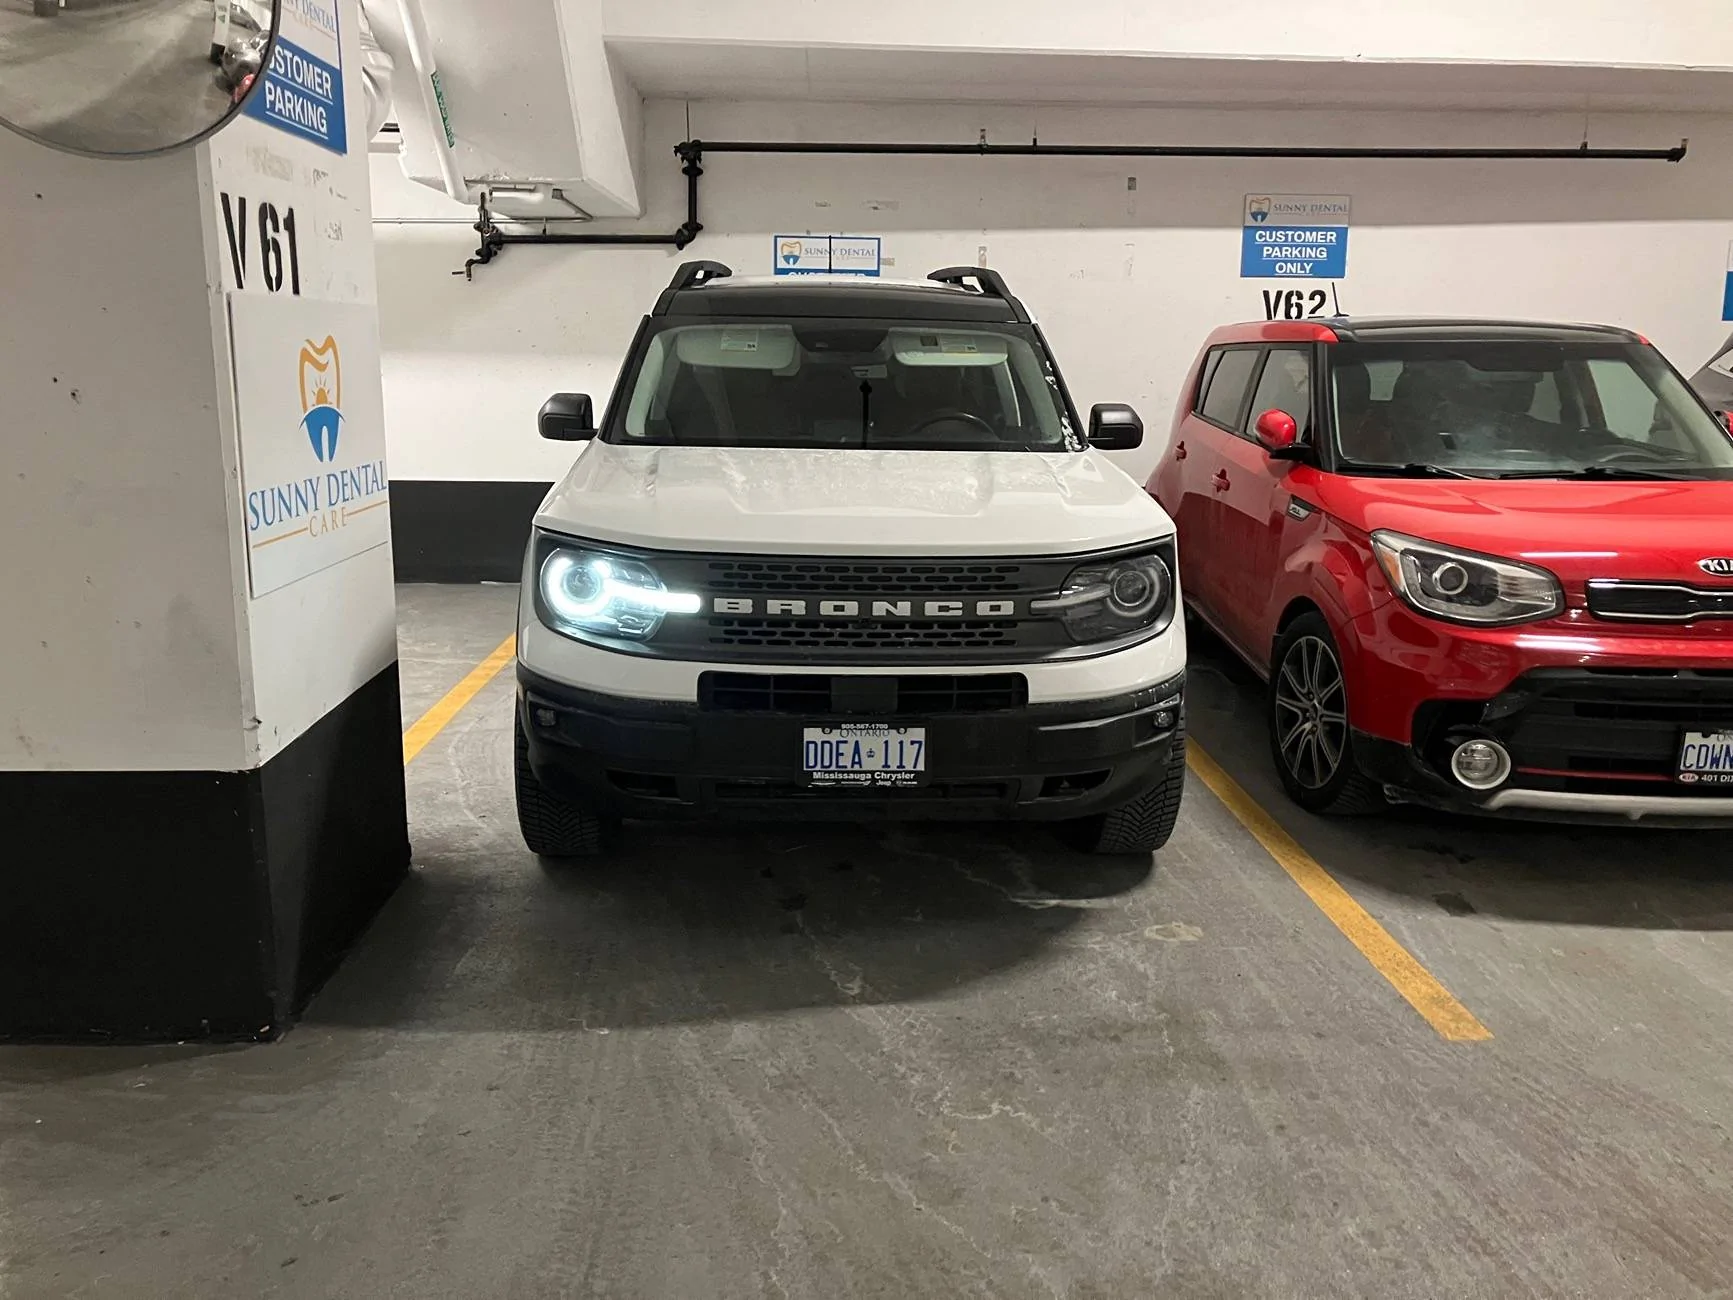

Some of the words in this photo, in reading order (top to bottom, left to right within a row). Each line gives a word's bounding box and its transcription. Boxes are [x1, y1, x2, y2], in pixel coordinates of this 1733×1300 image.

[264, 80, 328, 134] PARKING
[1273, 203, 1307, 212] SUNNY
[1310, 203, 1347, 212] DENTAL
[1255, 230, 1337, 243] CUSTOMER
[804, 247, 838, 256] SUNNY
[840, 247, 876, 257] DENTAL
[1263, 247, 1328, 259] PARKING
[1275, 262, 1313, 274] ONLY
[1262, 289, 1327, 320] V62
[248, 476, 321, 531] SUNNY
[326, 460, 387, 508] DENTAL
[309, 506, 348, 537] CARE
[1707, 559, 1733, 571] KI
[714, 597, 1015, 616] BRONCO
[840, 729, 889, 738] ONTARIO
[805, 740, 863, 769] DDEA
[881, 740, 924, 769] 117
[812, 771, 872, 781] Mississauga
[874, 771, 915, 781] Chrysler
[1701, 774, 1718, 782] 401
